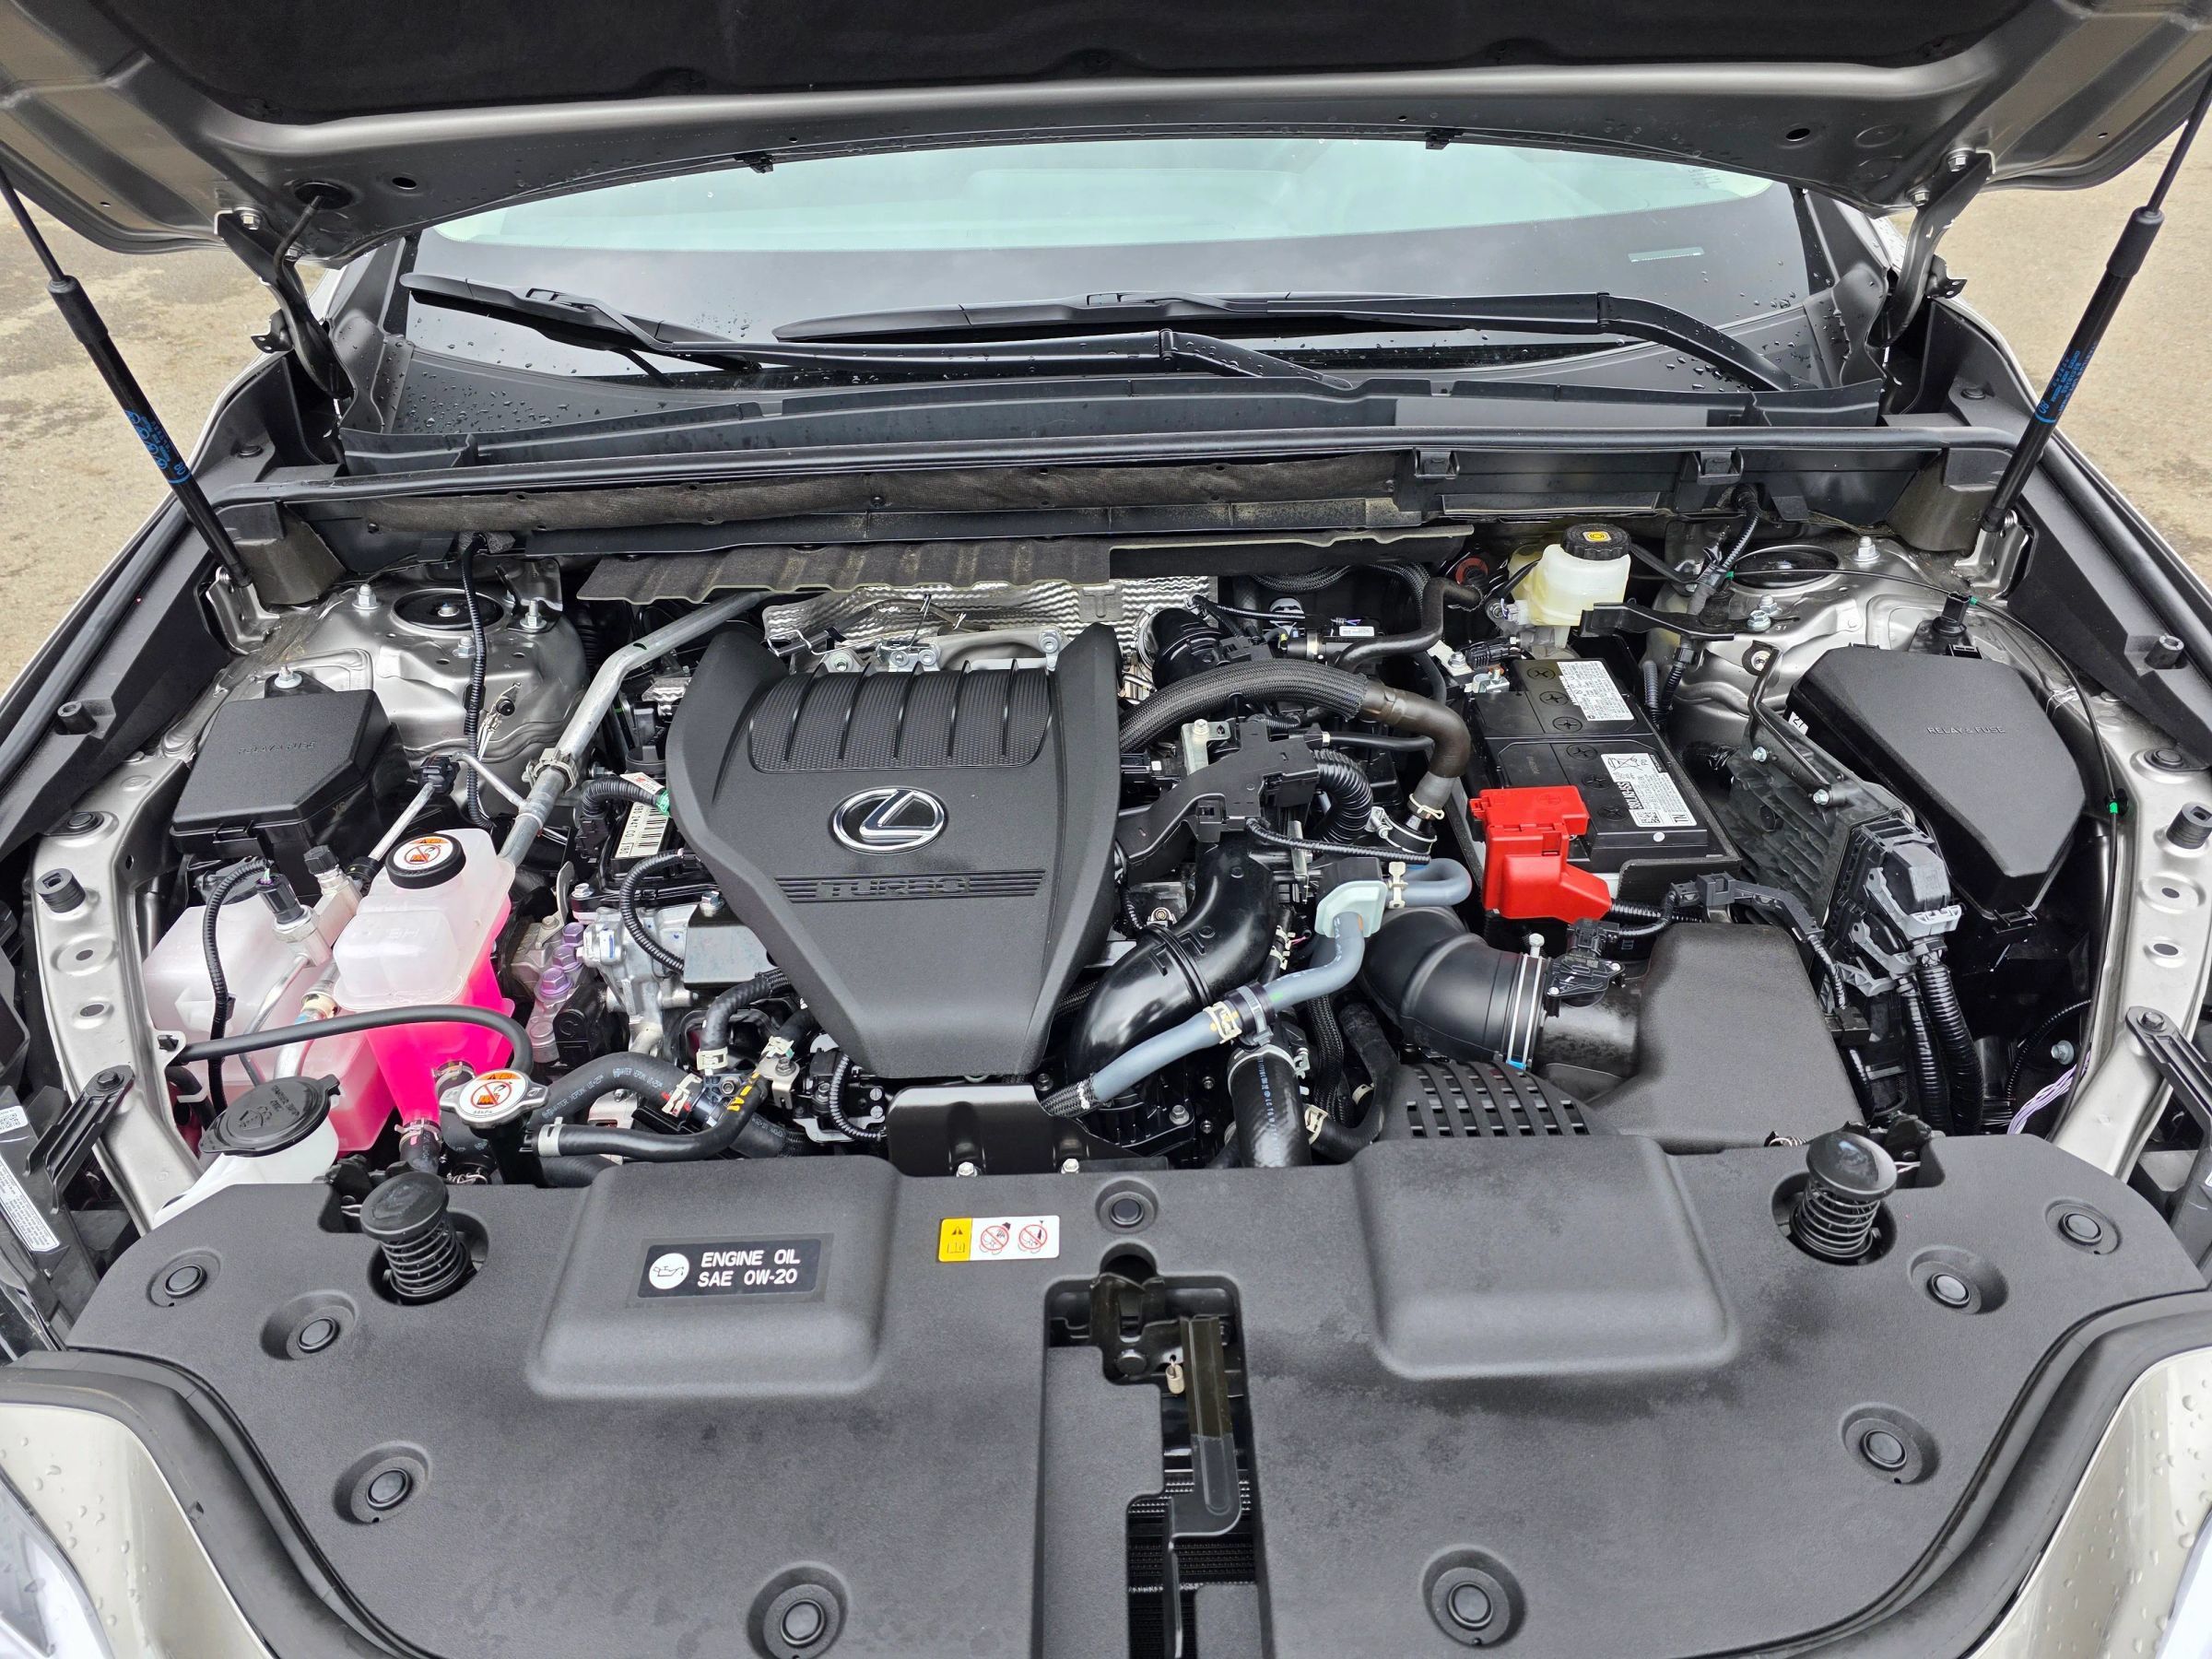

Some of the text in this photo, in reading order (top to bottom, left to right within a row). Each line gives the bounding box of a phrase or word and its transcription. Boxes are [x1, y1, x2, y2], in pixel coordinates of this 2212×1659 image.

[1926, 726, 1963, 735] RELAY
[1974, 725, 2006, 734] FUSE
[820, 876, 966, 897] TURBO
[700, 1248, 801, 1267] ENGINE OIL
[697, 1268, 798, 1288] SAE 0W-20
